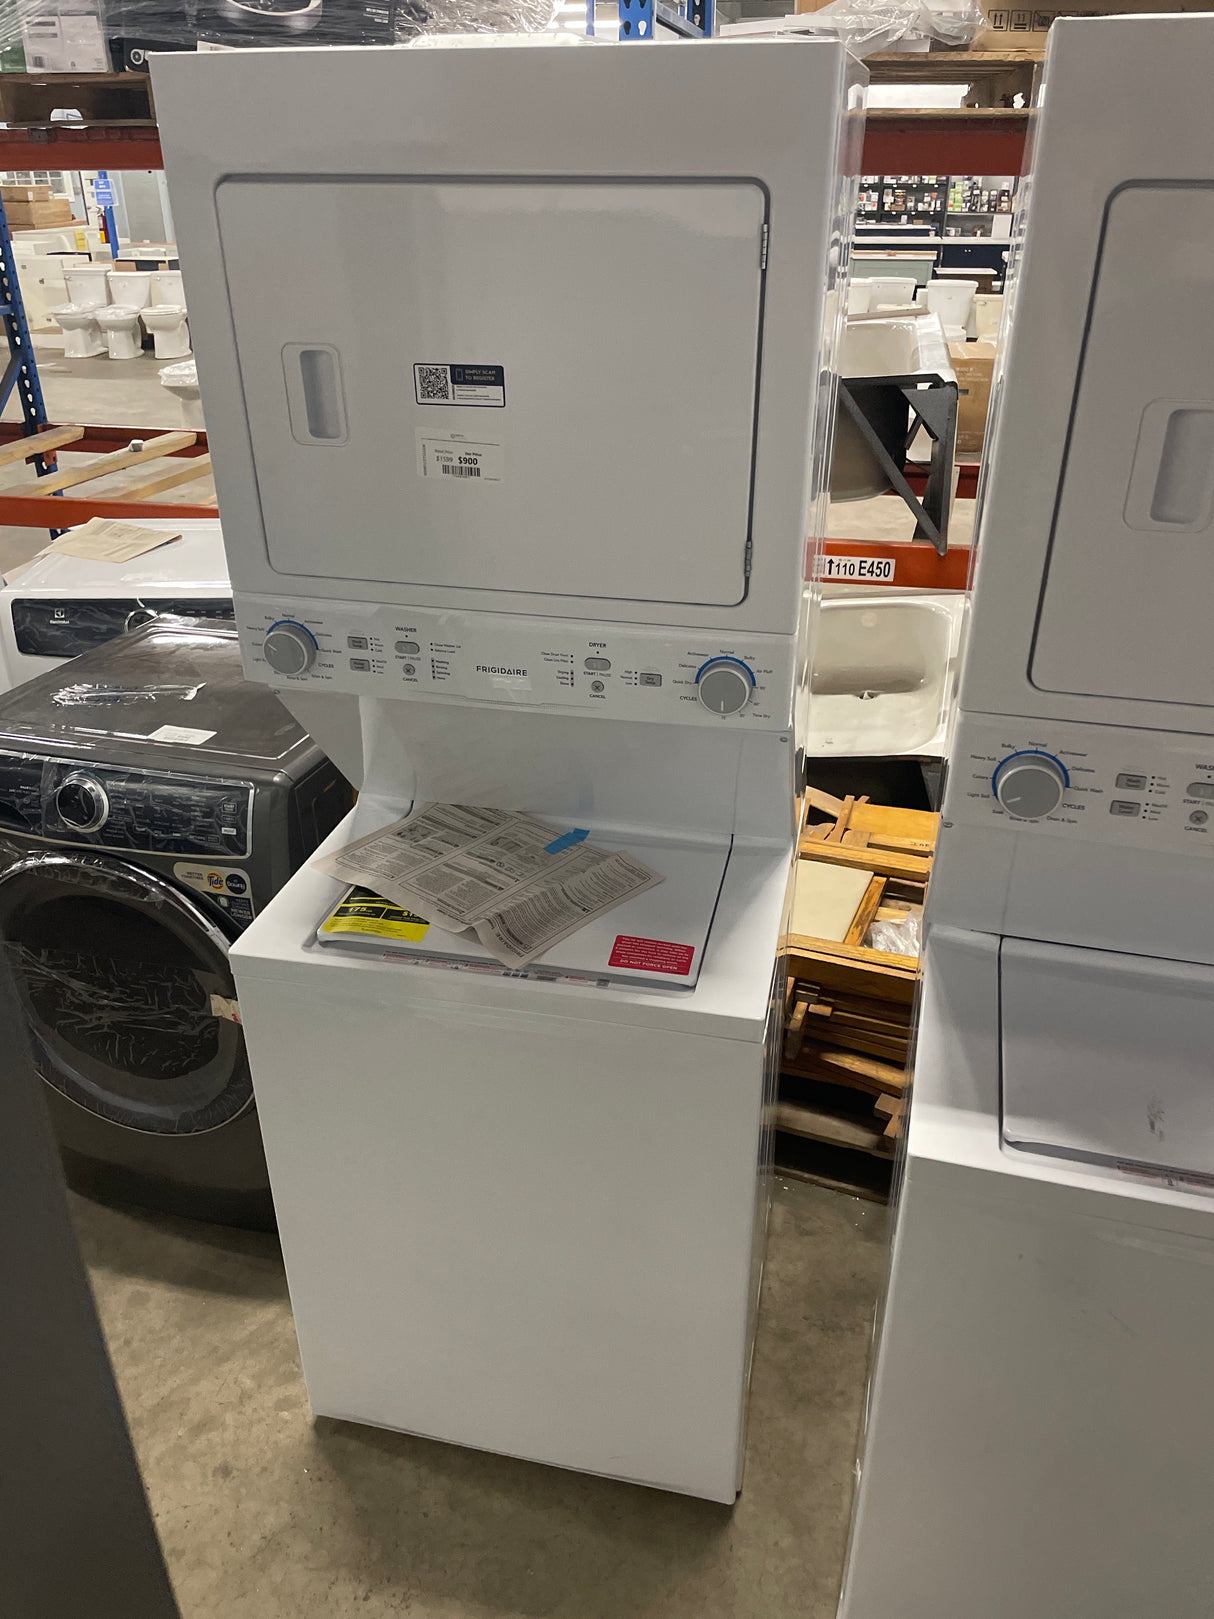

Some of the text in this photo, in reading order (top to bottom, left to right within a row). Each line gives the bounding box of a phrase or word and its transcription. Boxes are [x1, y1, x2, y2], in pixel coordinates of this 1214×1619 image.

[458, 456, 478, 465] $900
[835, 560, 891, 577] 110 E450
[476, 665, 528, 676] FRIGIDAIRE
[1184, 825, 1208, 833] CANCEL
[207, 875, 224, 887] Tide
[226, 880, 246, 890] Downy
